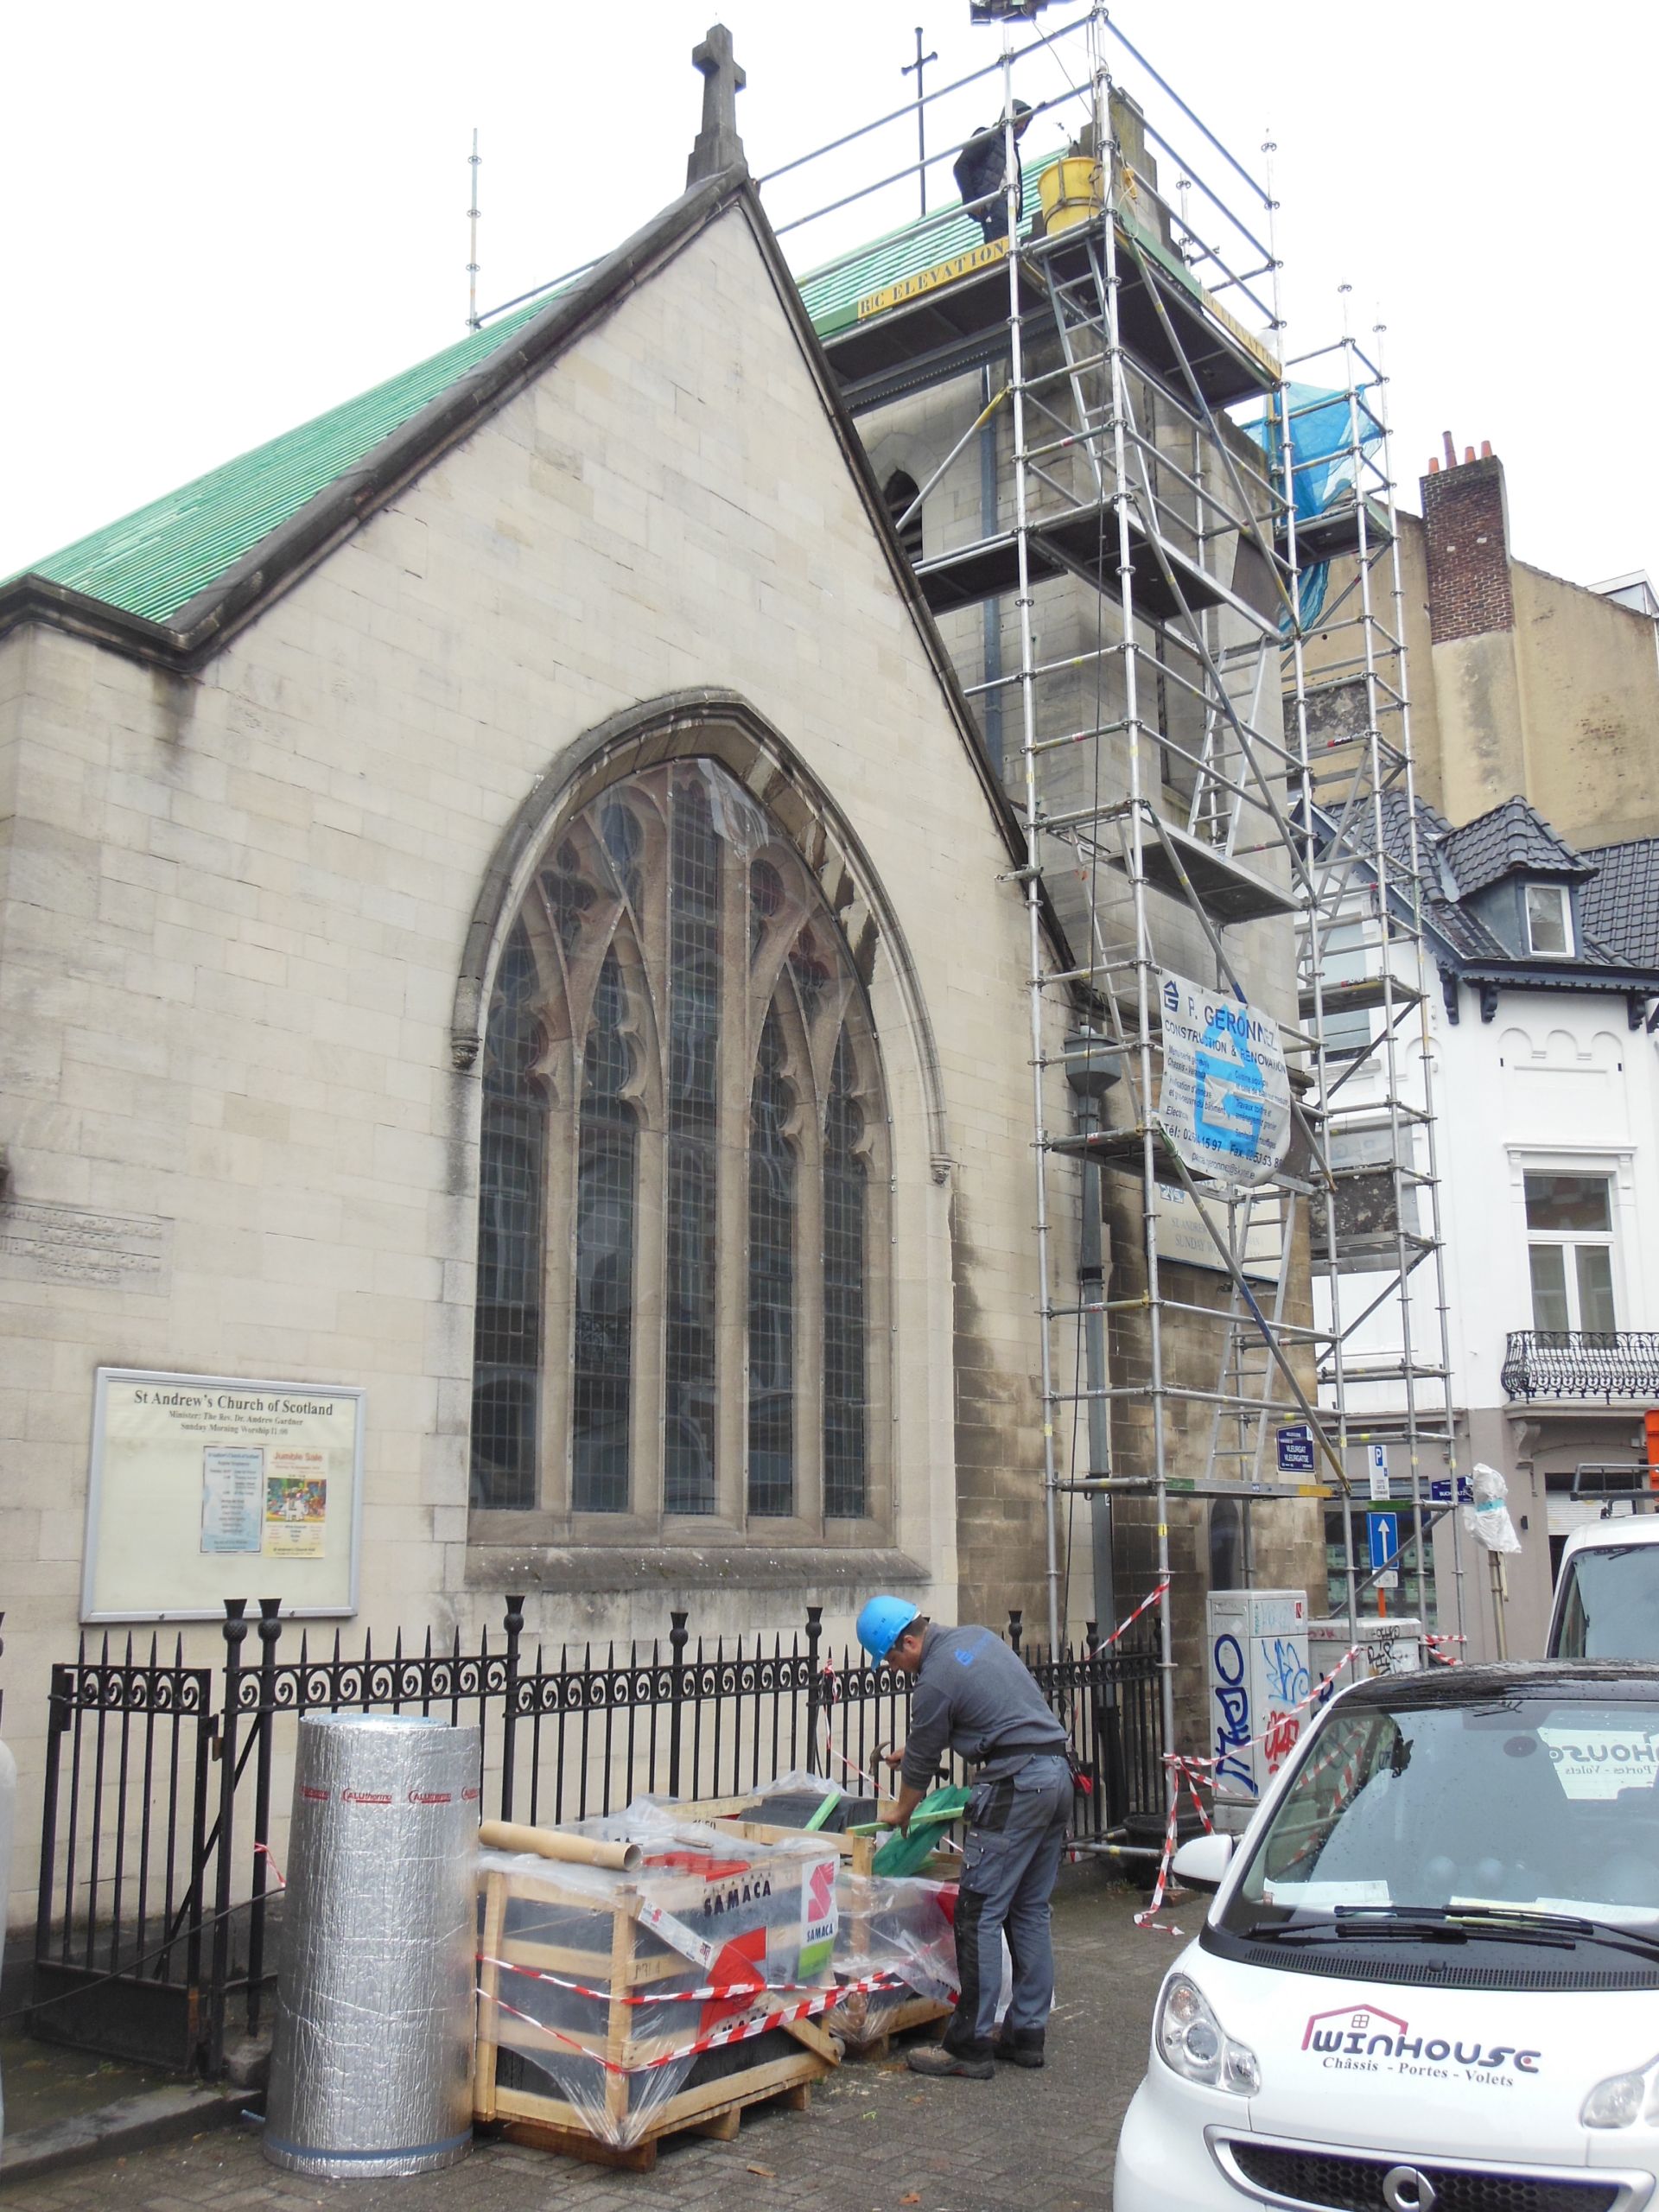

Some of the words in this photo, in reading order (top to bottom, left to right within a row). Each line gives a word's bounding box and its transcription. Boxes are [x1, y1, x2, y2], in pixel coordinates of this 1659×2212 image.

[893, 240, 1004, 301] ELEVATION
[1187, 996, 1198, 1020] P.
[1231, 1046, 1236, 1058] &
[1240, 1048, 1287, 1074] RENOVATION
[134, 1389, 148, 1404] St
[151, 1392, 213, 1408] Andrew's
[218, 1395, 264, 1411] Church
[268, 1399, 281, 1413] of
[282, 1400, 334, 1416] Scotland
[169, 1410, 200, 1420] Minister:
[203, 1412, 217, 1421] The
[234, 1414, 245, 1423] Dr.
[247, 1414, 274, 1424] Andrew
[275, 1416, 303, 1426] Gardner
[181, 1422, 207, 1433] Sunday
[209, 1423, 238, 1434] Morning
[241, 1426, 270, 1436] Worship
[274, 1452, 303, 1461] Jumble
[305, 1452, 323, 1462] Sale
[703, 1879, 772, 1917] SAMACA
[807, 1923, 834, 1942] SAMACA
[1323, 2056, 1379, 2072] Châssis
[1399, 2062, 1449, 2079] Portes
[1465, 2069, 1515, 2088] Volets
